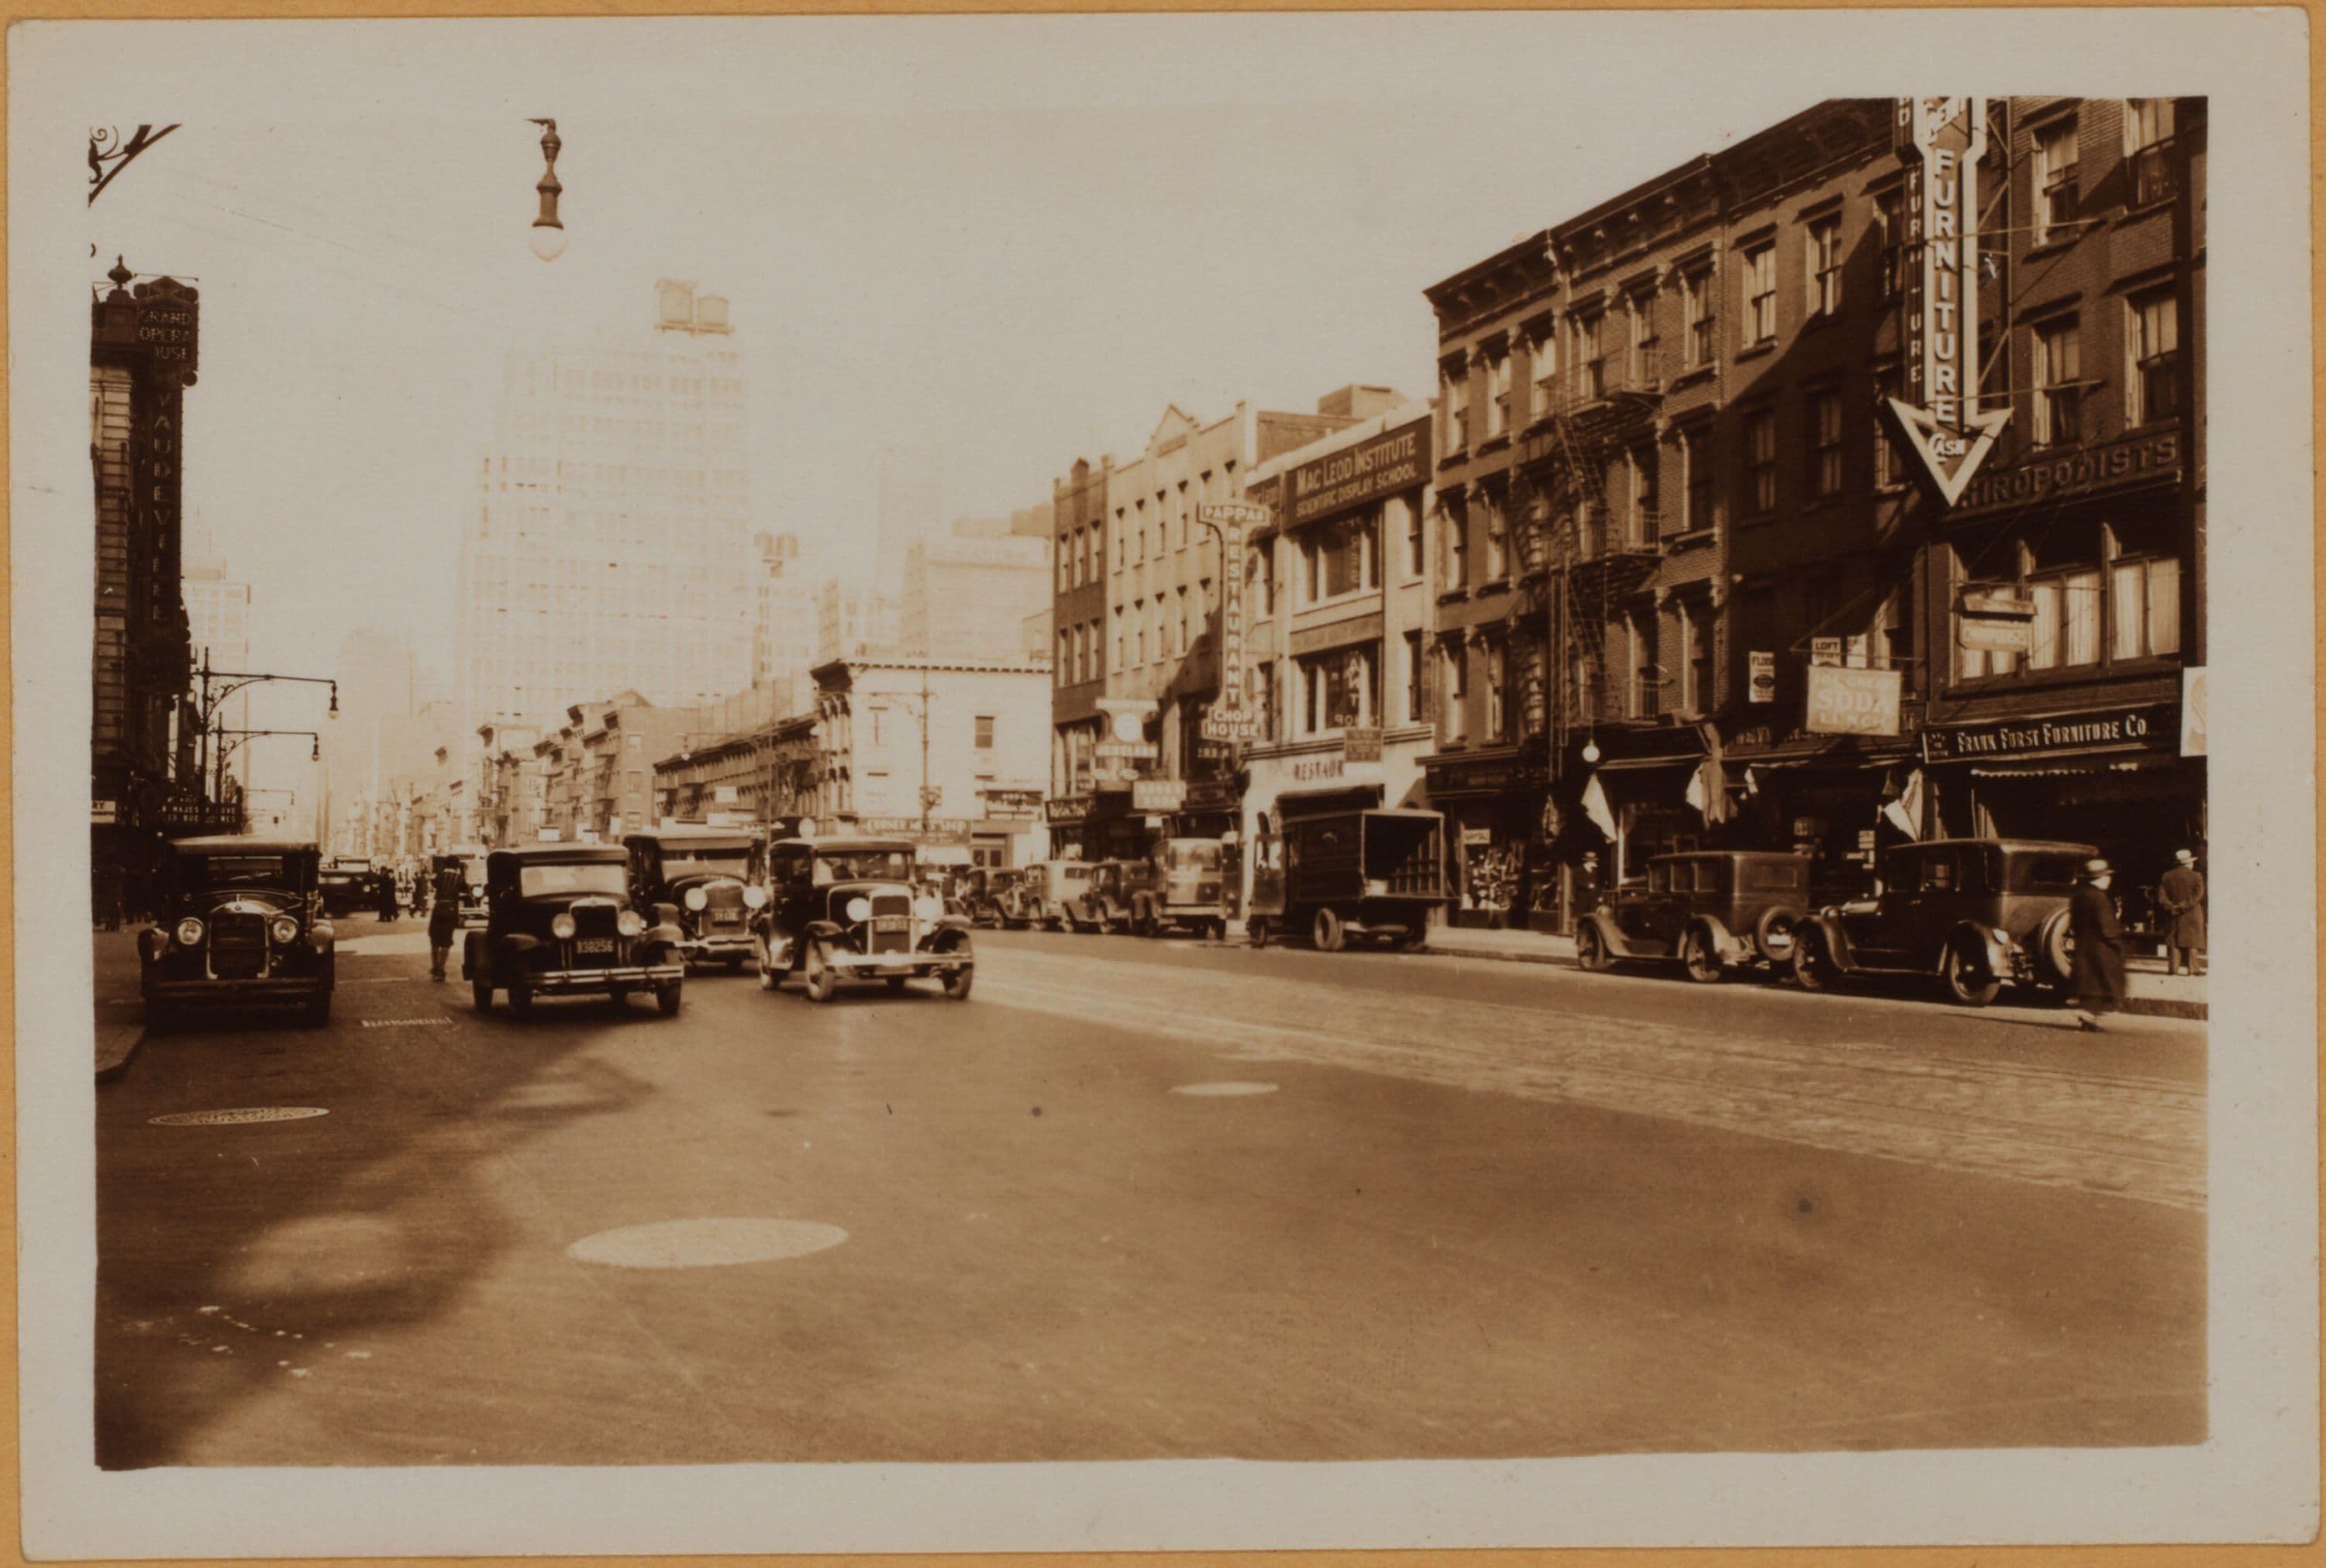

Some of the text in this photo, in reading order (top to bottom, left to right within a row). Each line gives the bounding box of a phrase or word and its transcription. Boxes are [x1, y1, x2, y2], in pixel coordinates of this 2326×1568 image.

[1934, 149, 1956, 423] FURNITURE
[1296, 436, 1416, 497] MAC LEOD INSTITUTE
[1376, 462, 1417, 488] SCHOOL
[1227, 527, 1241, 704] RESTAURANT
[1815, 641, 1838, 650] LOFT
[1207, 722, 1258, 737] HOUSE
[1214, 709, 1253, 722] CHOP
[1957, 732, 1997, 753] FRANK
[2000, 728, 2039, 750] FURST
[2042, 722, 2120, 745] FURNITURE
